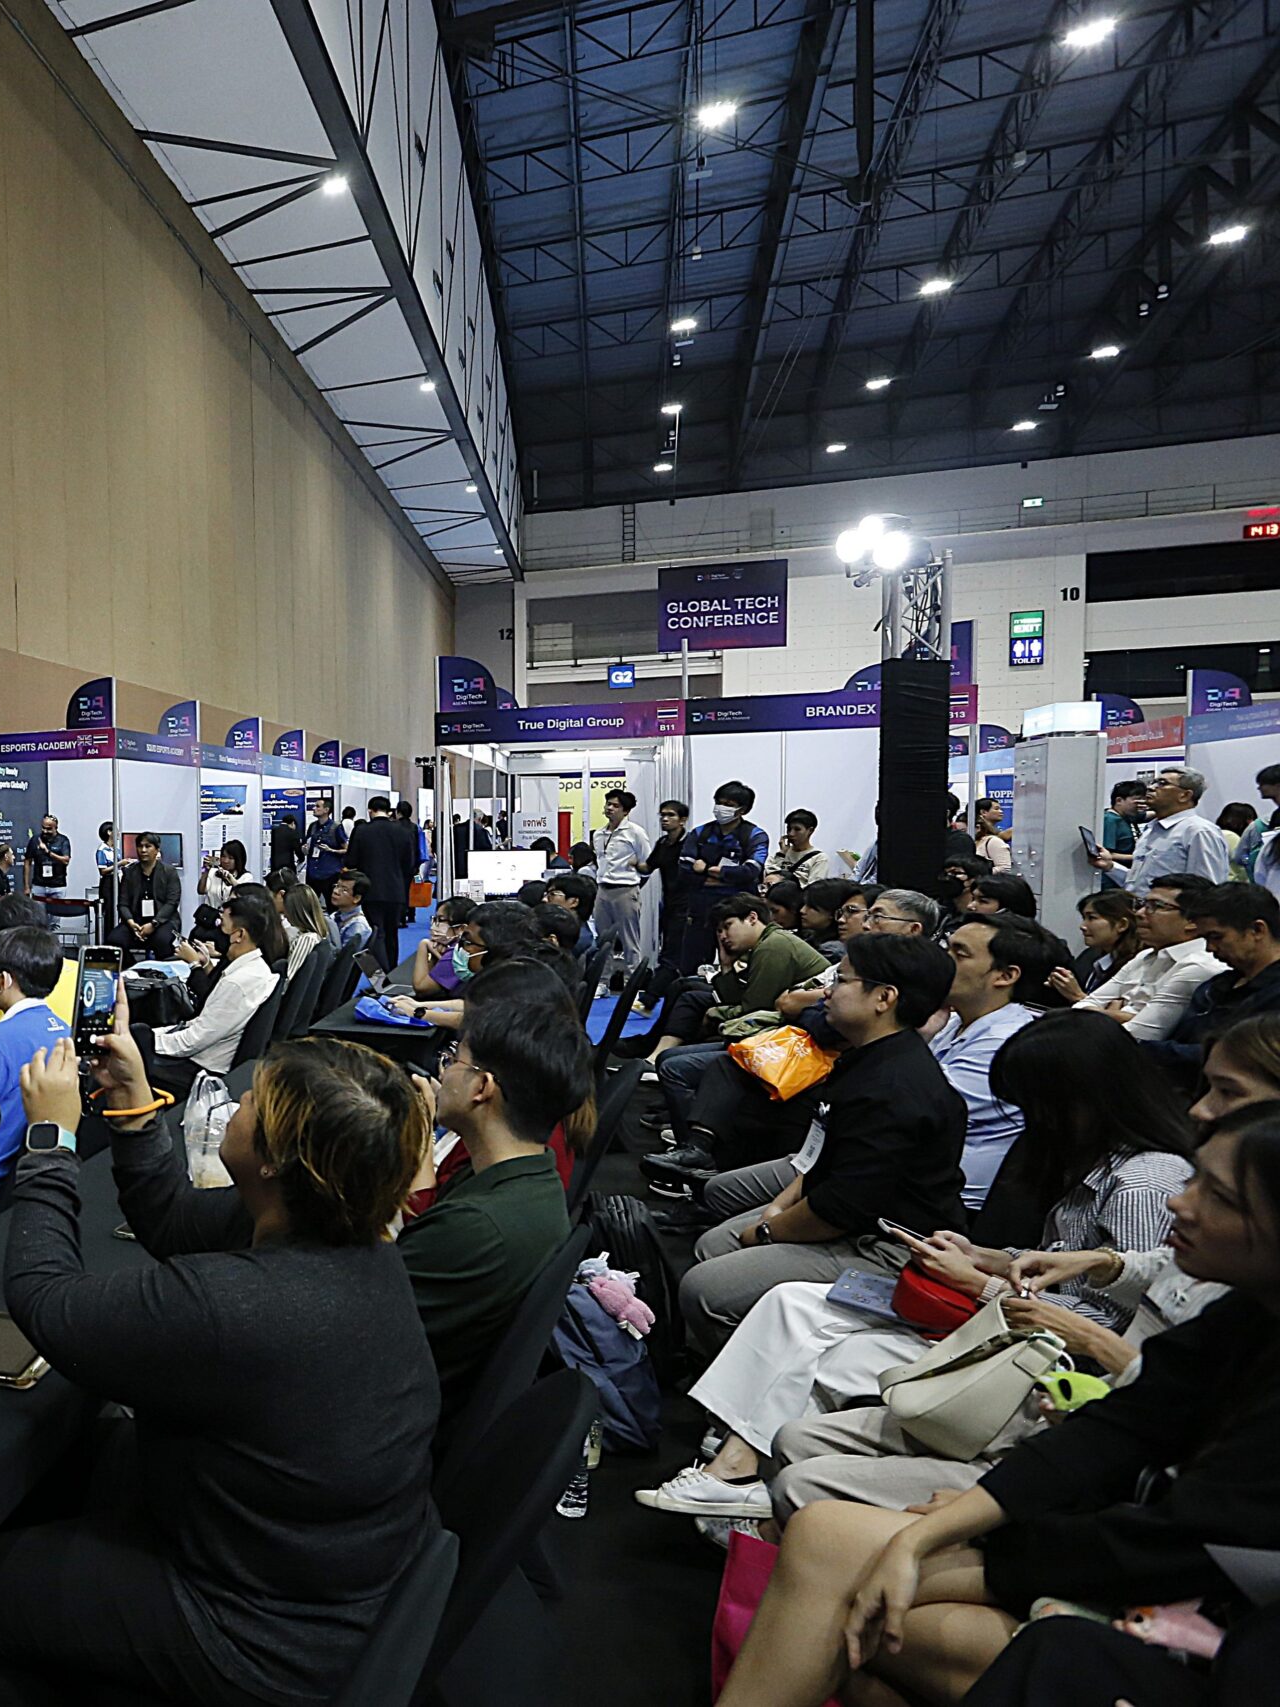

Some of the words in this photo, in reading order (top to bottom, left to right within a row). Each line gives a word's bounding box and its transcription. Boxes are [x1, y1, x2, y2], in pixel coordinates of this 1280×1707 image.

[1060, 586, 1080, 601] 10
[667, 600, 730, 614] GLOBAL
[735, 596, 779, 609] TECH
[667, 612, 779, 630] CONFERENCE
[1014, 623, 1041, 633] EXIT
[499, 628, 513, 640] 12
[611, 670, 633, 684] G2
[517, 720, 544, 730] True
[547, 718, 583, 731] Digital
[587, 717, 624, 729] Group
[1, 744, 36, 752] ESPORTS
[37, 741, 77, 751] ACADEMY
[523, 817, 547, 828] แจกฟรี
